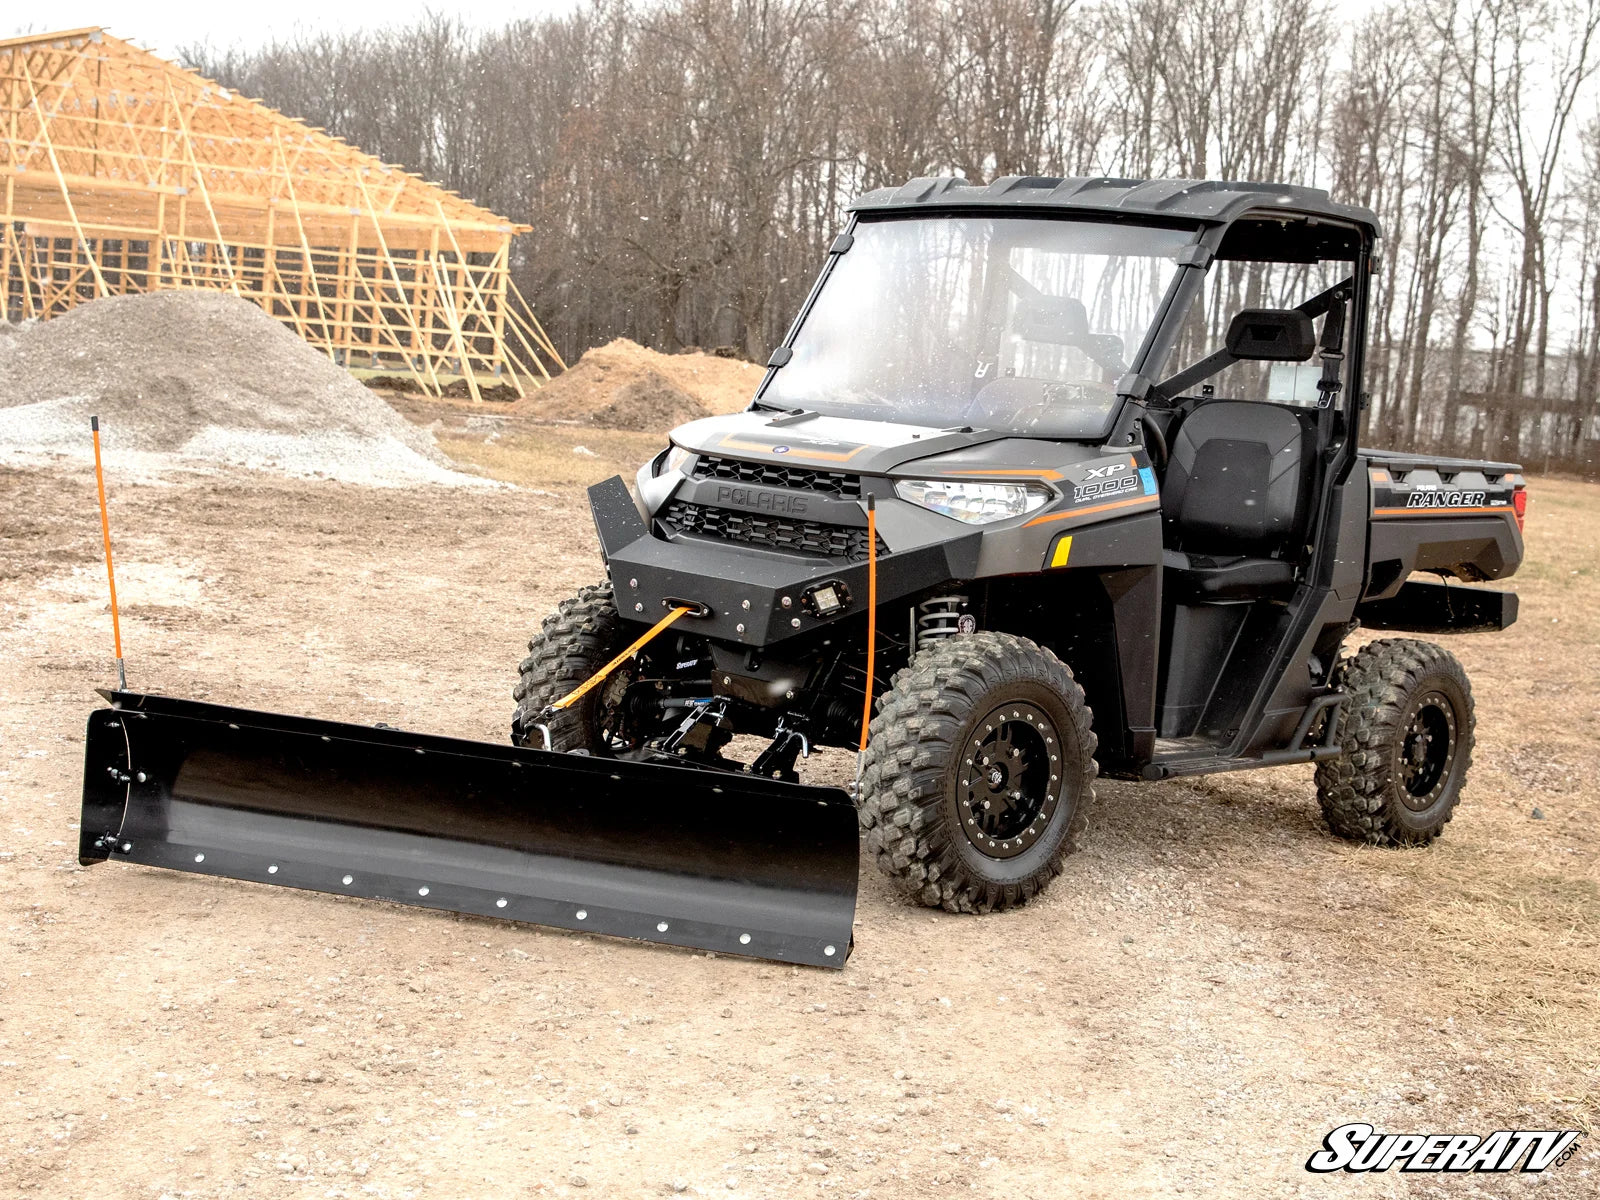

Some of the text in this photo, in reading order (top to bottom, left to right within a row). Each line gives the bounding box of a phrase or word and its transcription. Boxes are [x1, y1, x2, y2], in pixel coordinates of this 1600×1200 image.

[1083, 463, 1126, 481] XP
[1074, 474, 1138, 499] 1000
[718, 486, 808, 514] POLARIS
[1406, 491, 1486, 508] RANGER
